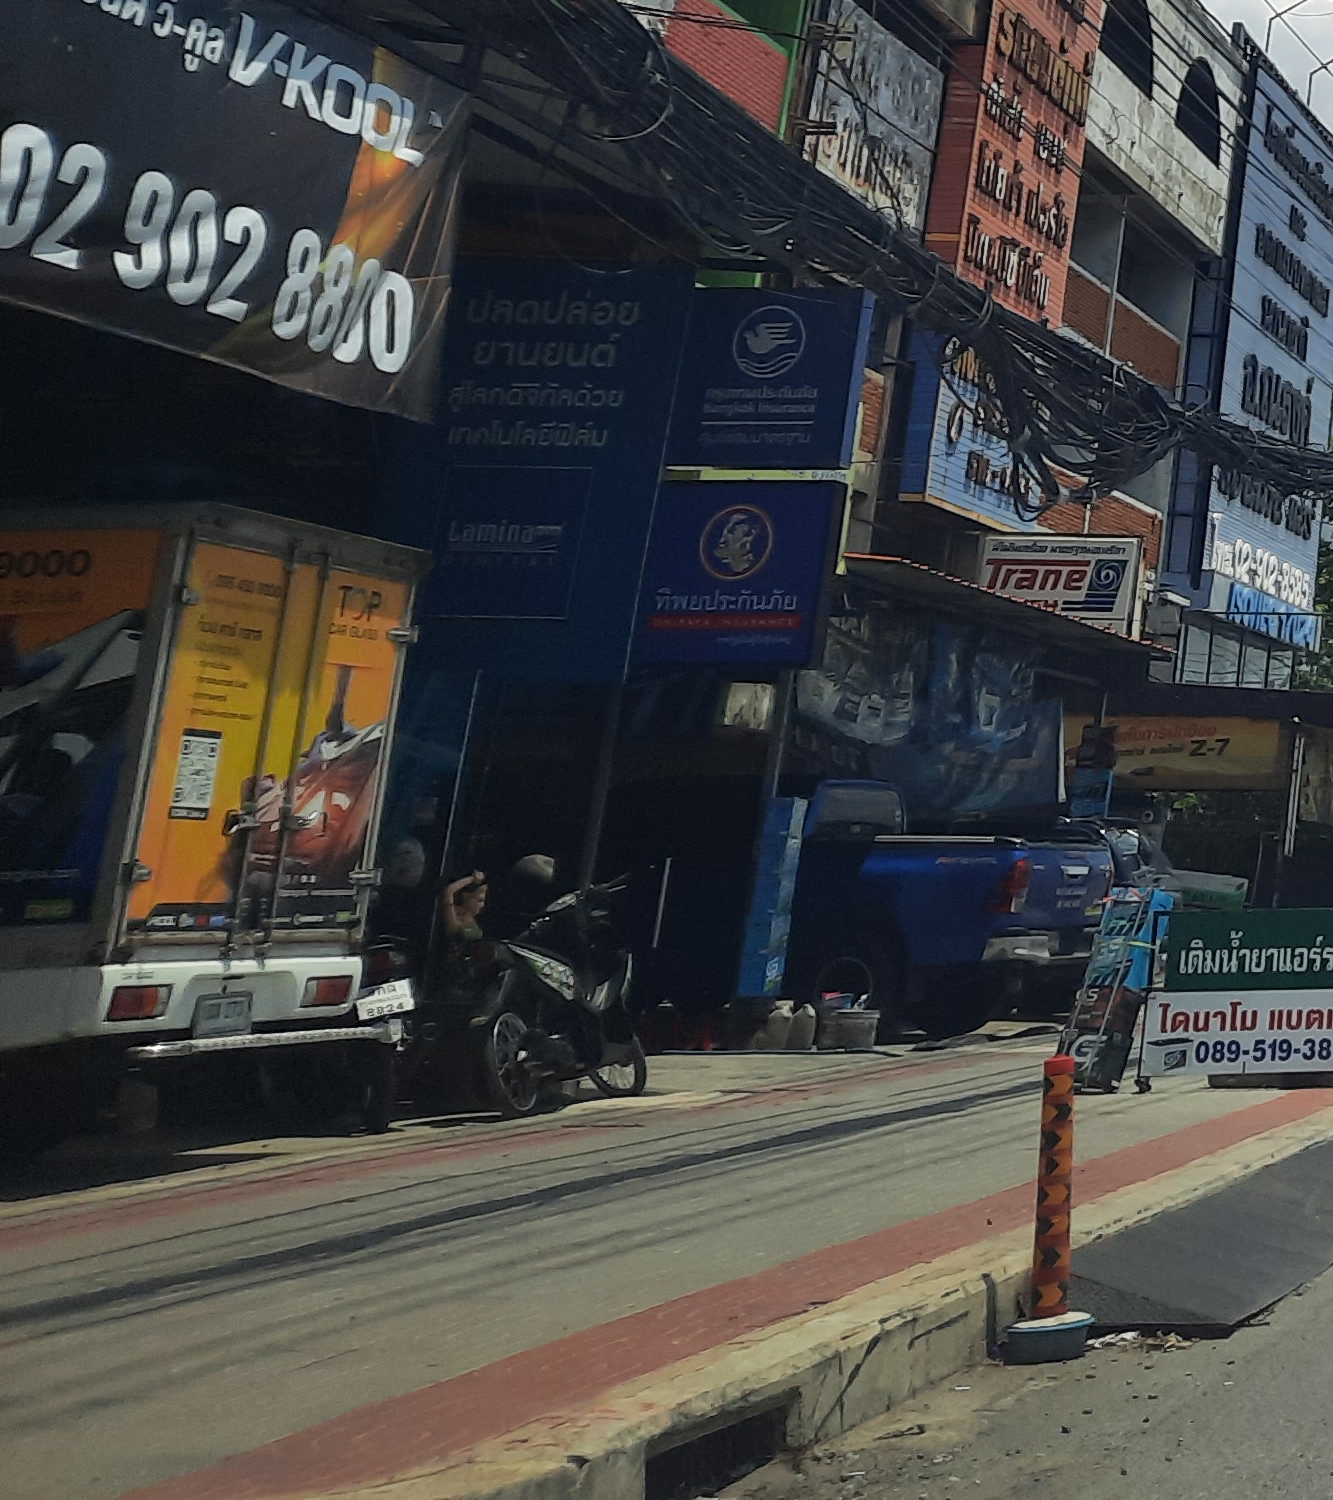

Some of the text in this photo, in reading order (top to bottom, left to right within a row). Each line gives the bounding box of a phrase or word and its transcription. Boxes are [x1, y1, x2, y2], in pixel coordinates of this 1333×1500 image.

[227, 12, 427, 168] V-KOOL
[0, 122, 106, 271] 02
[112, 171, 268, 322] 902
[467, 289, 641, 327] ปลดปล่อย
[473, 333, 621, 368] ยานยนต์
[985, 559, 1092, 591] Trane
[655, 587, 797, 613] ทิพยประกันภัย
[1189, 738, 1230, 757] Z-7
[1158, 1001, 1258, 1033] ไดนาโม
